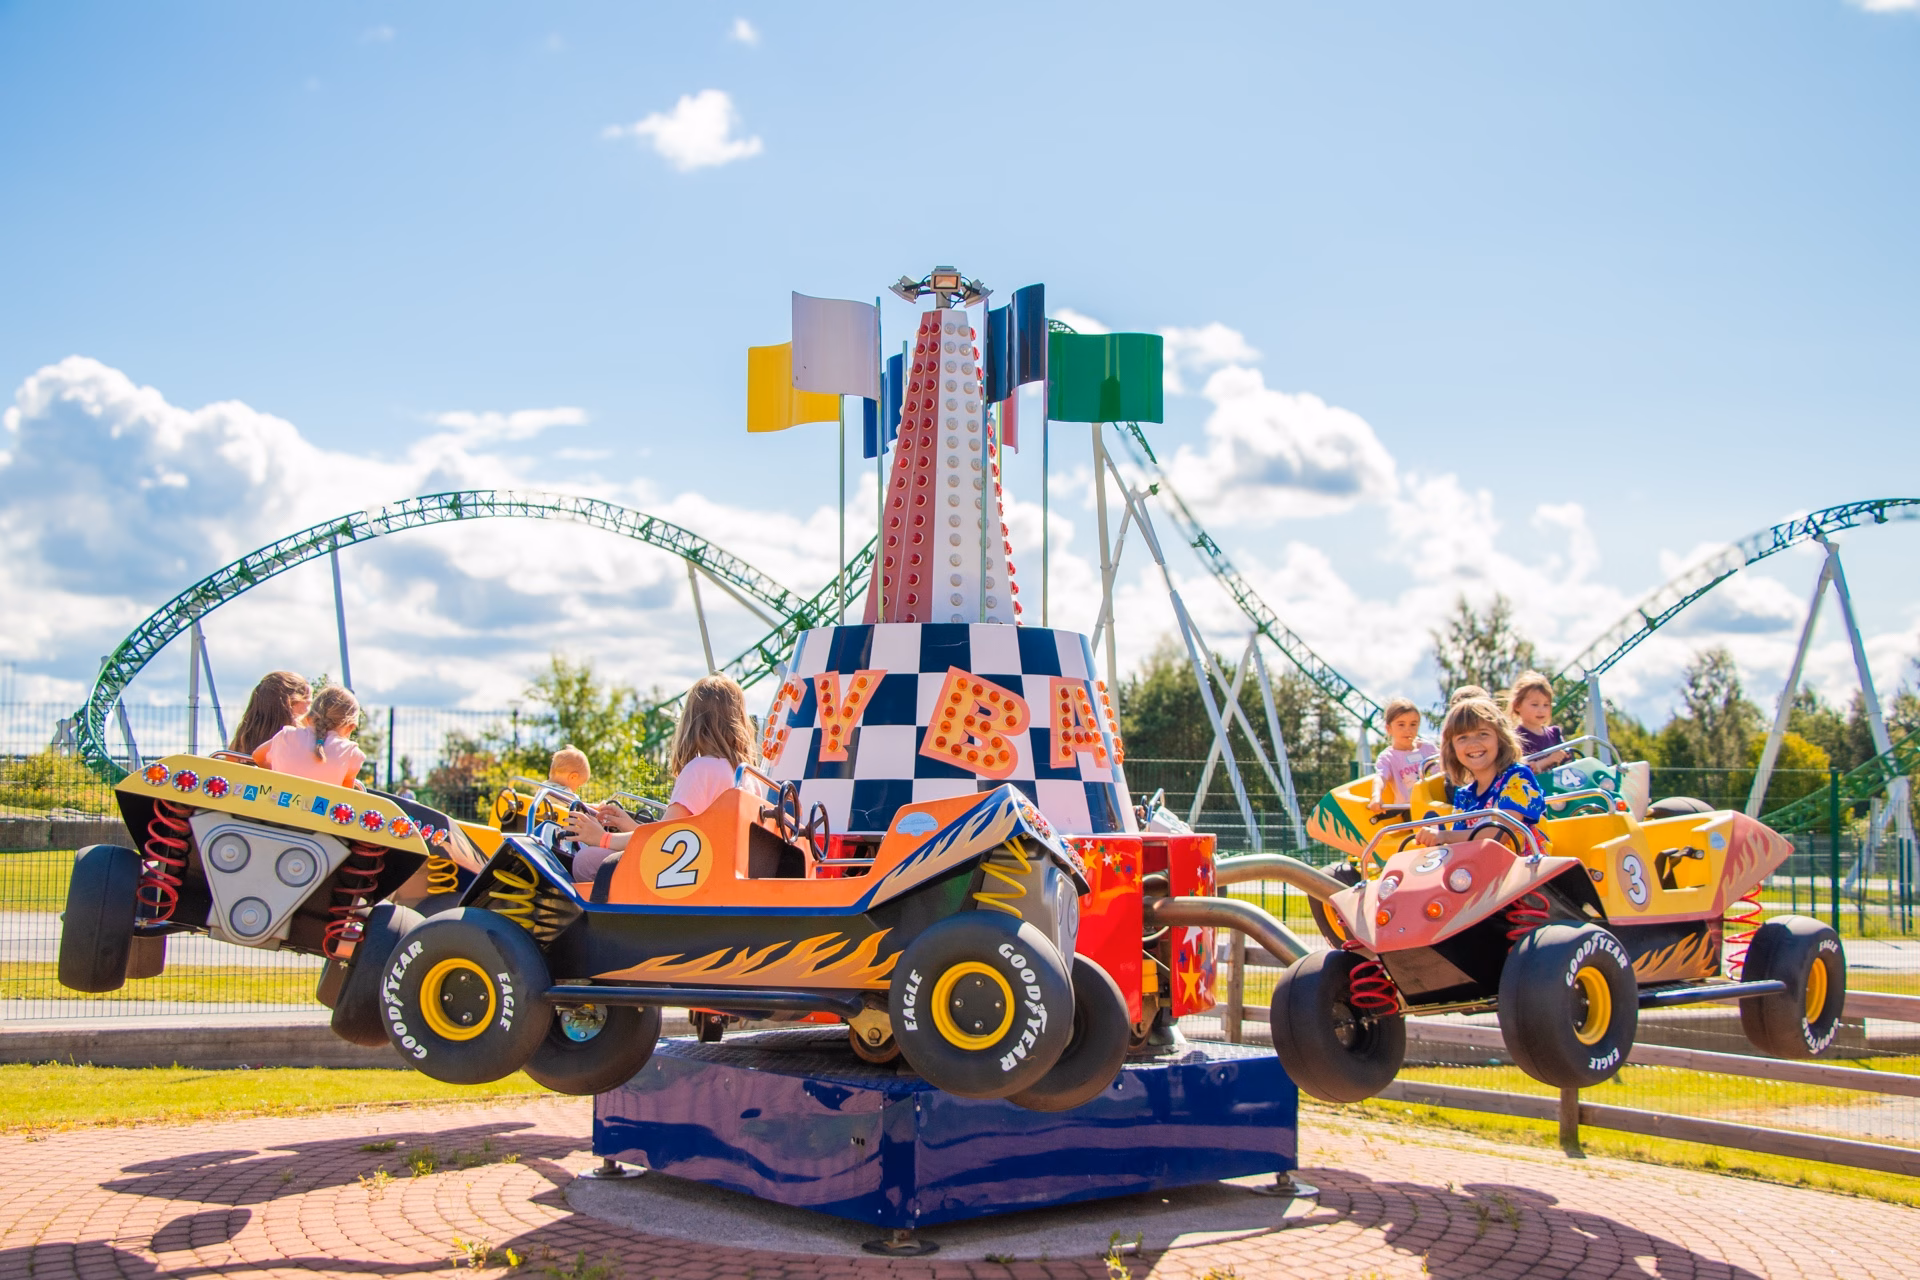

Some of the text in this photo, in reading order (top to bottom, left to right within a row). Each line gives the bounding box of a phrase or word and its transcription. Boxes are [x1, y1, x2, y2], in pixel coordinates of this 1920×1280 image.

[919, 665, 1124, 780] BA
[232, 783, 329, 815] ZAMERLA
[1561, 769, 1581, 787] 4
[656, 829, 702, 889] 2
[1415, 848, 1449, 873] 3
[1622, 854, 1648, 905] 3
[1565, 932, 1629, 987] GOODYEAR
[383, 940, 428, 1059] GOODYEAR
[497, 972, 515, 1031] EAGLE
[902, 969, 923, 1031] EAGLE
[998, 943, 1048, 1072] GOODYEAR
[1588, 1047, 1620, 1071] EAGLE
